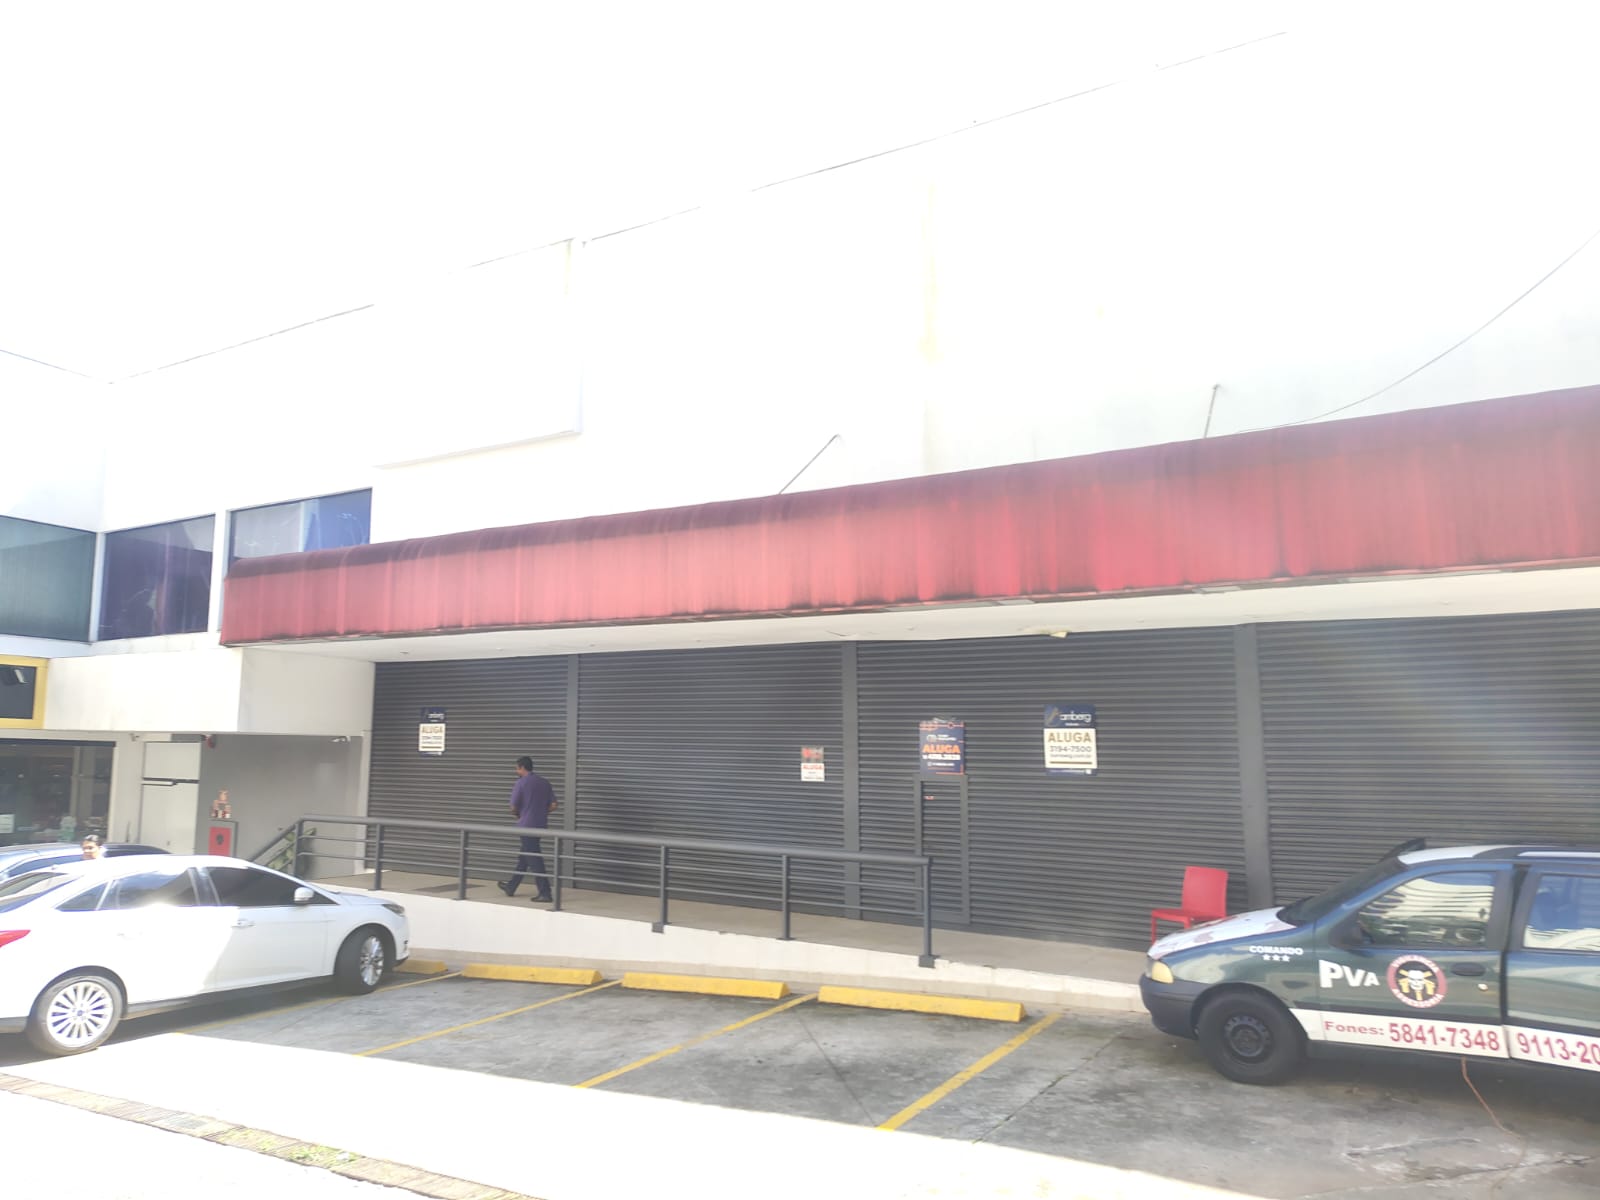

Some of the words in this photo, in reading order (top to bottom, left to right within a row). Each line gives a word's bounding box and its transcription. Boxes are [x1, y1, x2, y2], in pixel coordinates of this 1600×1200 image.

[1048, 732, 1092, 743] ALUGA
[922, 744, 961, 753] ALUGA
[1250, 945, 1304, 956] COMANDO
[1319, 960, 1380, 988] PVA
[1324, 1021, 1385, 1035] Fones:
[1389, 1022, 1500, 1051] 5841-7348
